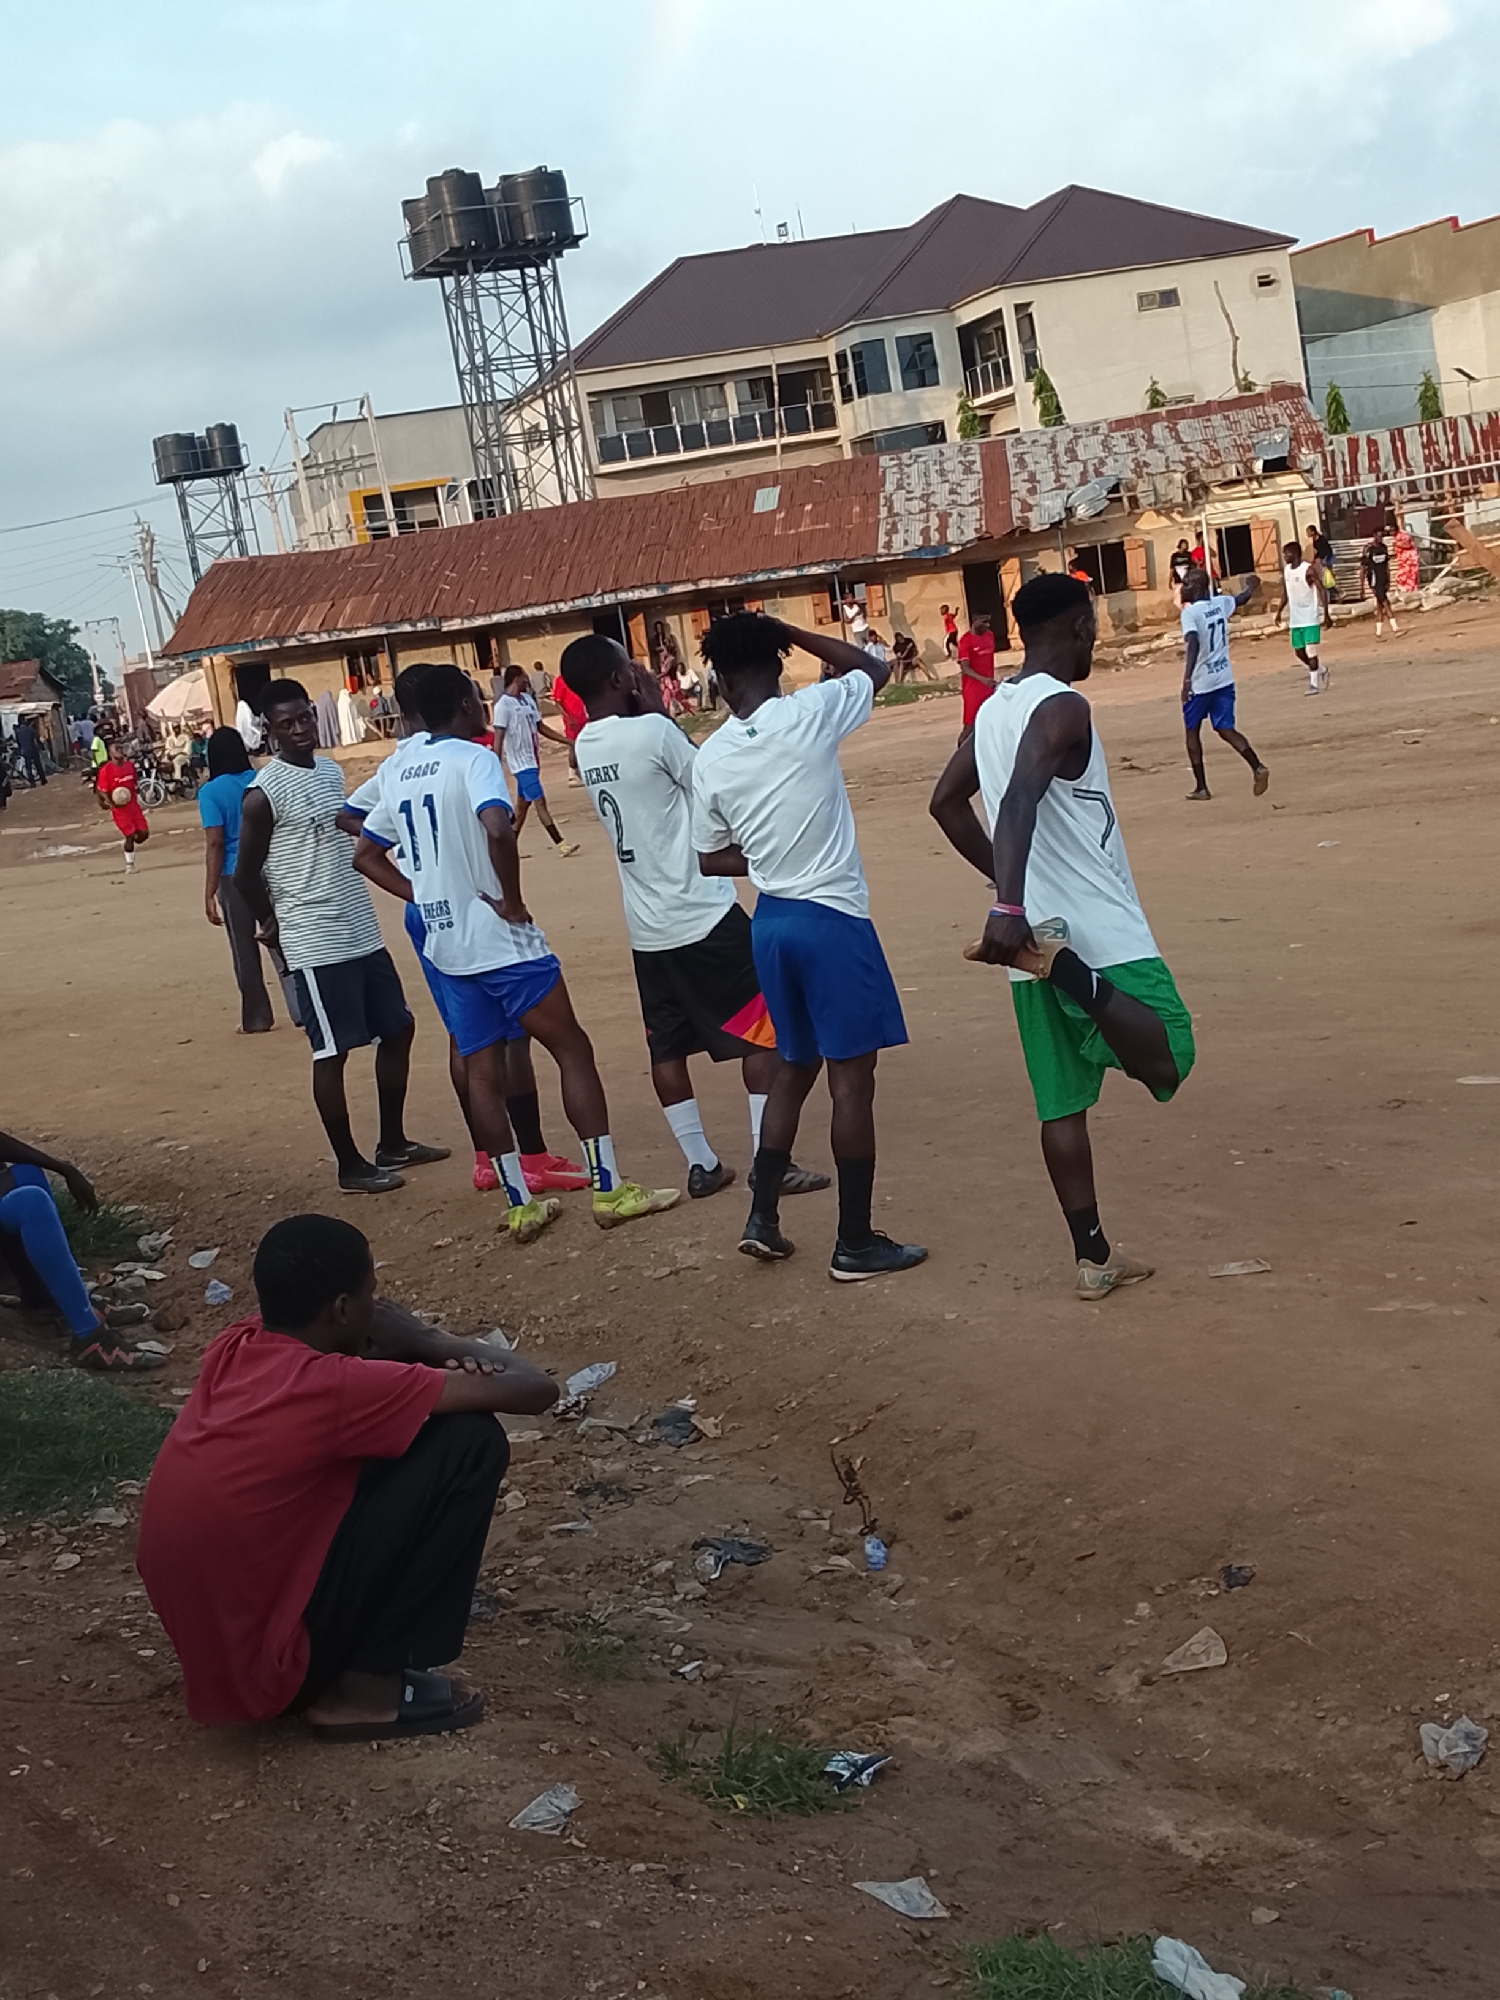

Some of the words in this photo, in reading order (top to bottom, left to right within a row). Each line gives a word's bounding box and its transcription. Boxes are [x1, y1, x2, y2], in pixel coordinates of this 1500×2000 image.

[399, 761, 441, 782] ISAAC
[583, 763, 620, 787] JERRY
[398, 793, 439, 872] 11
[598, 789, 635, 863] 2
